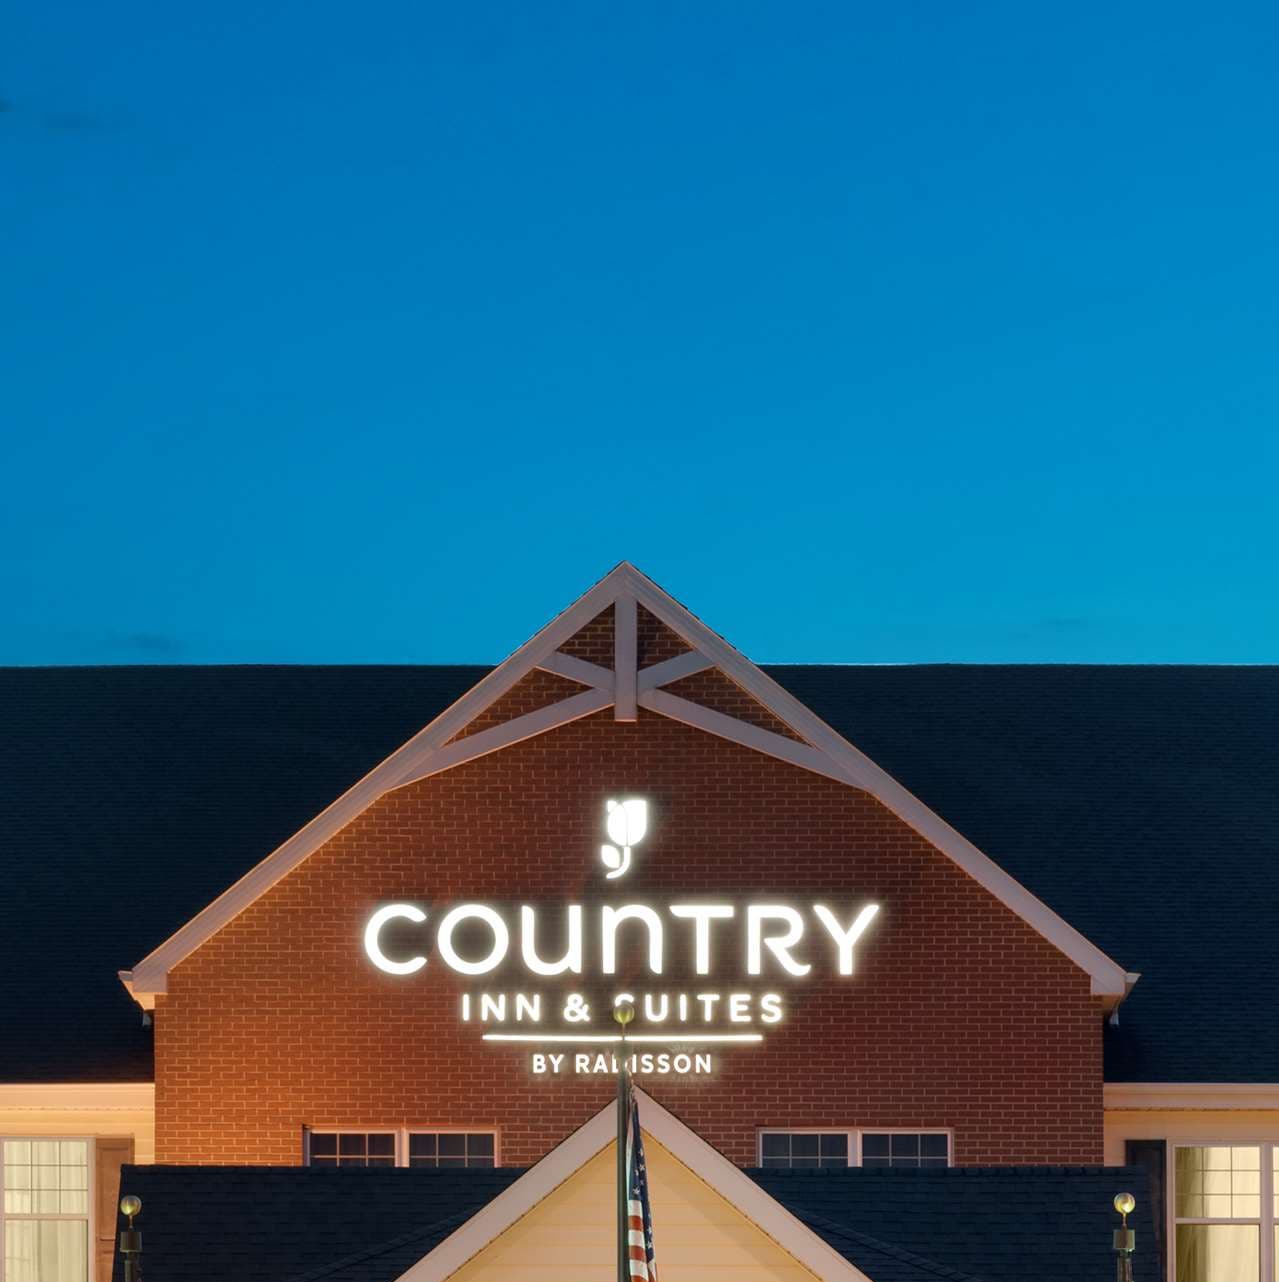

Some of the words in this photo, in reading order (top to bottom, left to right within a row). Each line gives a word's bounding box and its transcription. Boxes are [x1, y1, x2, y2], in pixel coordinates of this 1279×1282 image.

[462, 993, 541, 1022] INN
[563, 993, 591, 1023] &
[533, 1053, 564, 1074] BY
